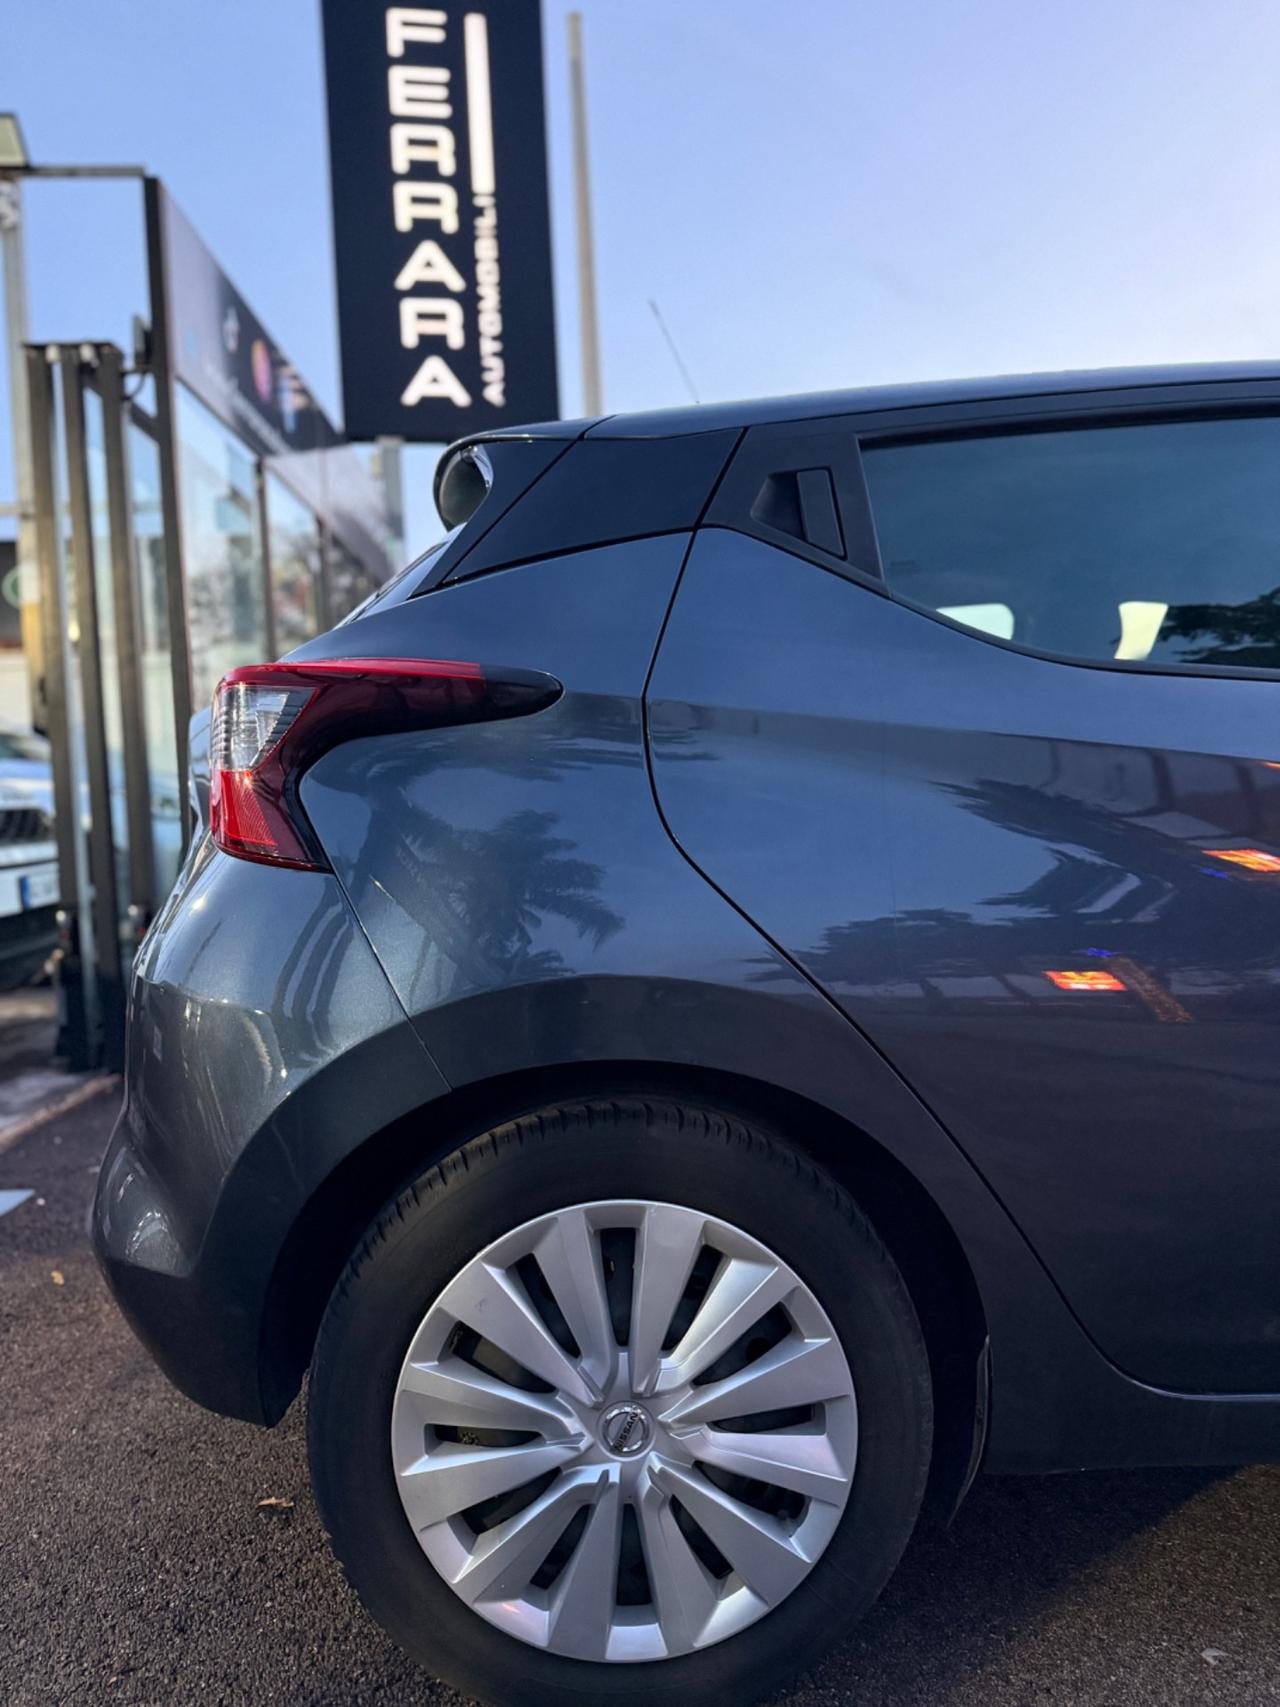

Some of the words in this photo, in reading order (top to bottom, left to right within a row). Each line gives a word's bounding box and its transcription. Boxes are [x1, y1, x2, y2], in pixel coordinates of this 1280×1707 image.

[385, 7, 471, 408] FERRARA
[472, 194, 506, 407] AUTOMOBILI
[613, 1411, 639, 1450] NISSAN
